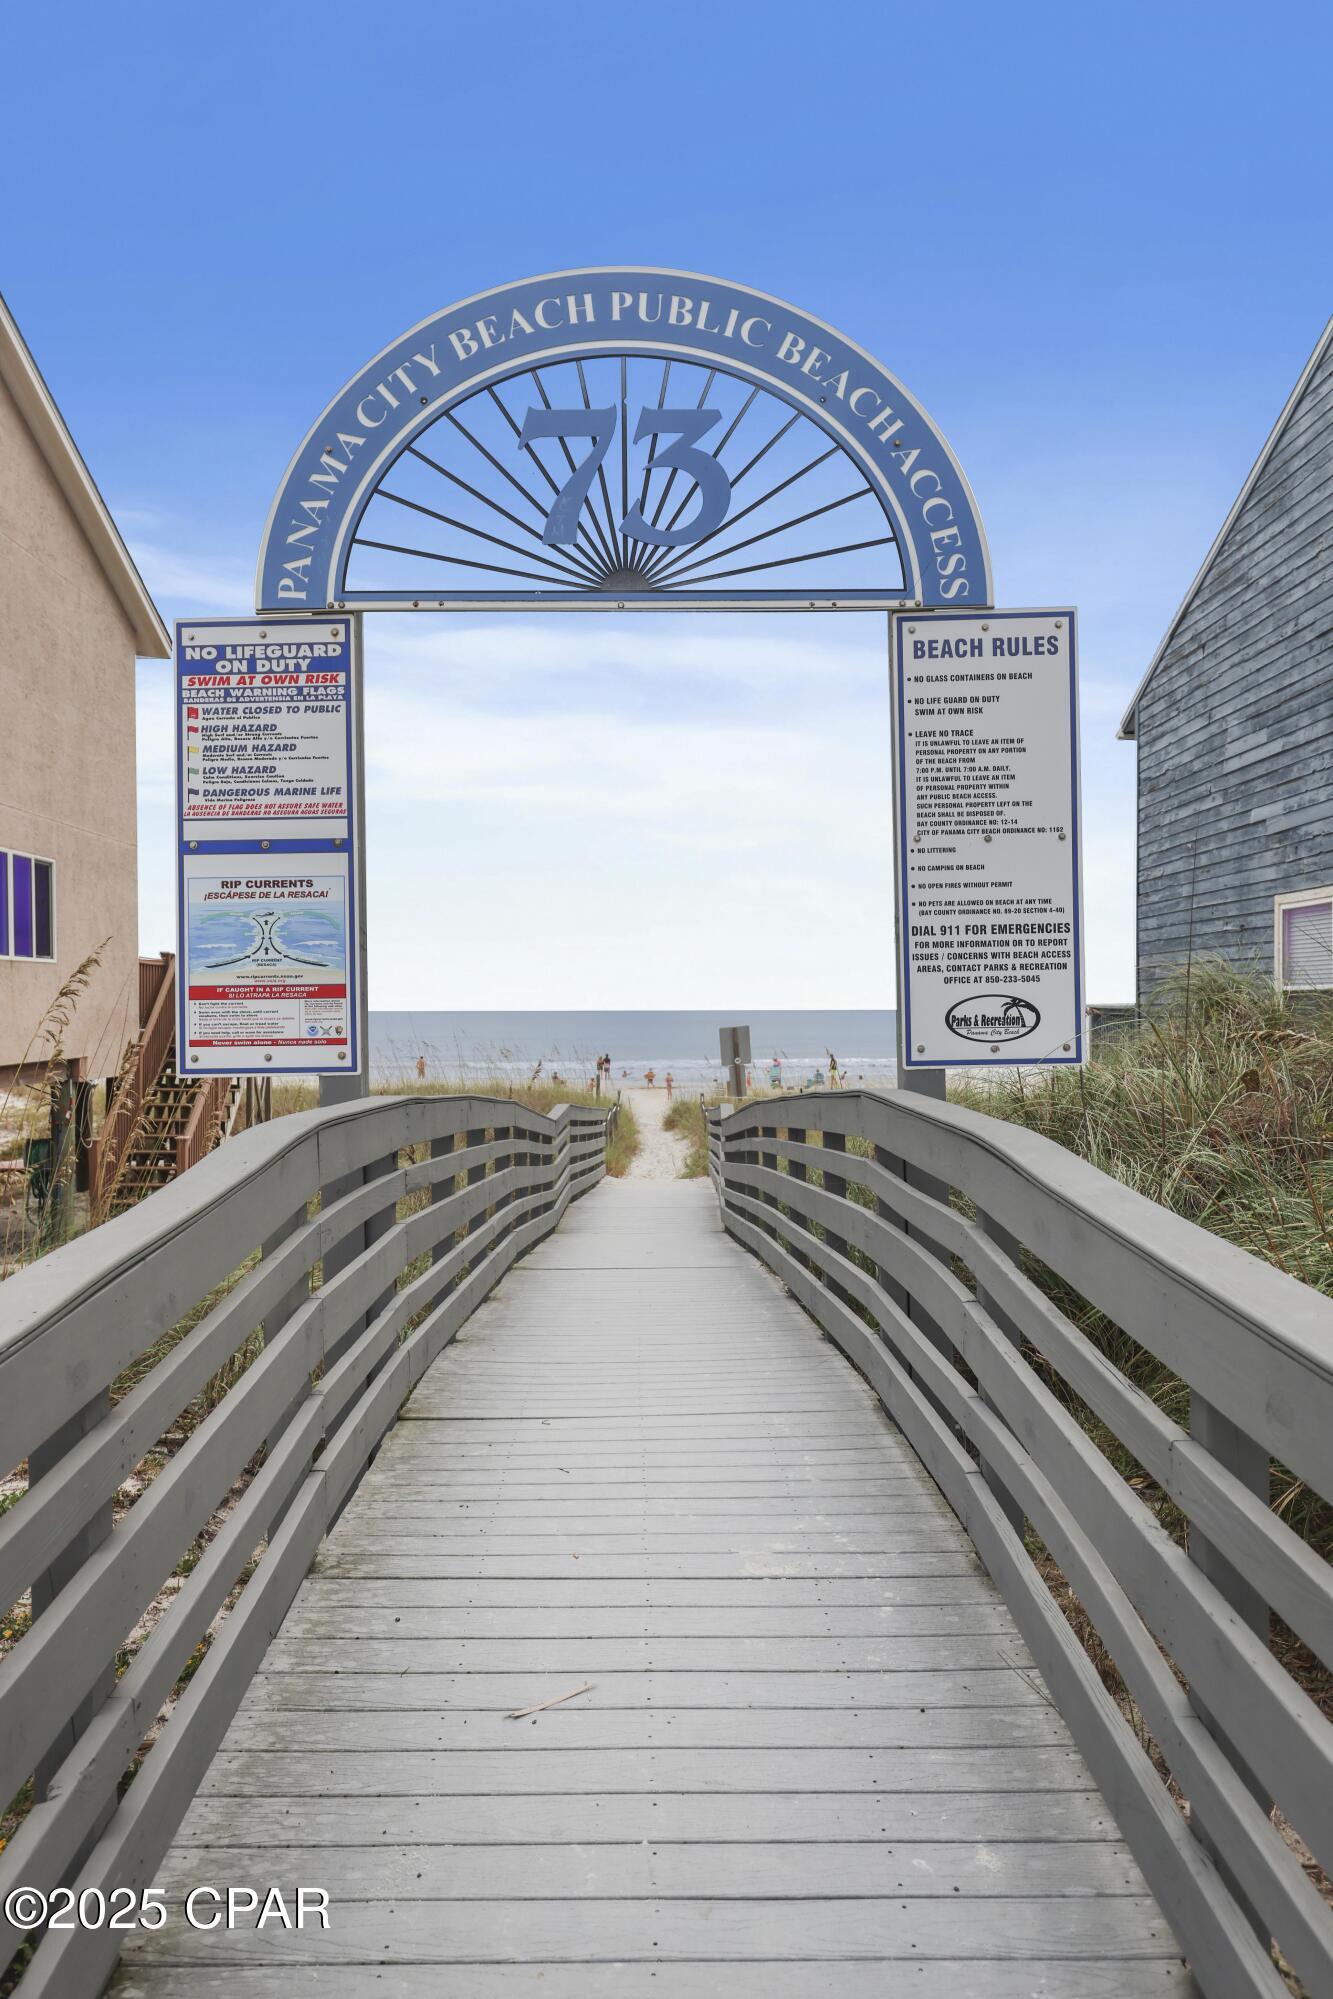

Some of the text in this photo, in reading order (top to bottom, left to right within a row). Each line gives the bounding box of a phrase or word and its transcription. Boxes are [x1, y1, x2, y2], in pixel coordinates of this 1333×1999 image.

[278, 291, 969, 600] PANAMA CITY BEACH PUBLIC BEACH ACCESS
[518, 402, 731, 547] 73
[186, 644, 341, 660] NO LIFEGUARD
[913, 636, 1059, 659] BEACH RULES
[216, 659, 311, 673] ON DUTY
[188, 674, 340, 686] SWIM AT OWN RISK
[182, 687, 344, 698] BEACH WARNING FLAGS
[202, 705, 341, 715] WATER CLOSED TO PUBLIC
[232, 724, 277, 732] HAZARD
[203, 744, 296, 753] MEDIUM HAZARD
[203, 766, 276, 775] LOW HAZARD
[203, 787, 341, 797] DANGEROUS MARINE LIFE
[221, 880, 314, 888] RIP CURRENTS
[912, 923, 1070, 936] DIAL 911 FOR EMERGENCIES
[957, 940, 1009, 948] INFORMATION
[912, 953, 938, 961] ISSUES
[947, 952, 988, 960] CONCERNS
[917, 965, 944, 973] AREAS,
[944, 976, 970, 984] OFFICE
[986, 975, 1040, 983] 850-233-5045
[952, 1014, 1020, 1027] Parks & Recreation
